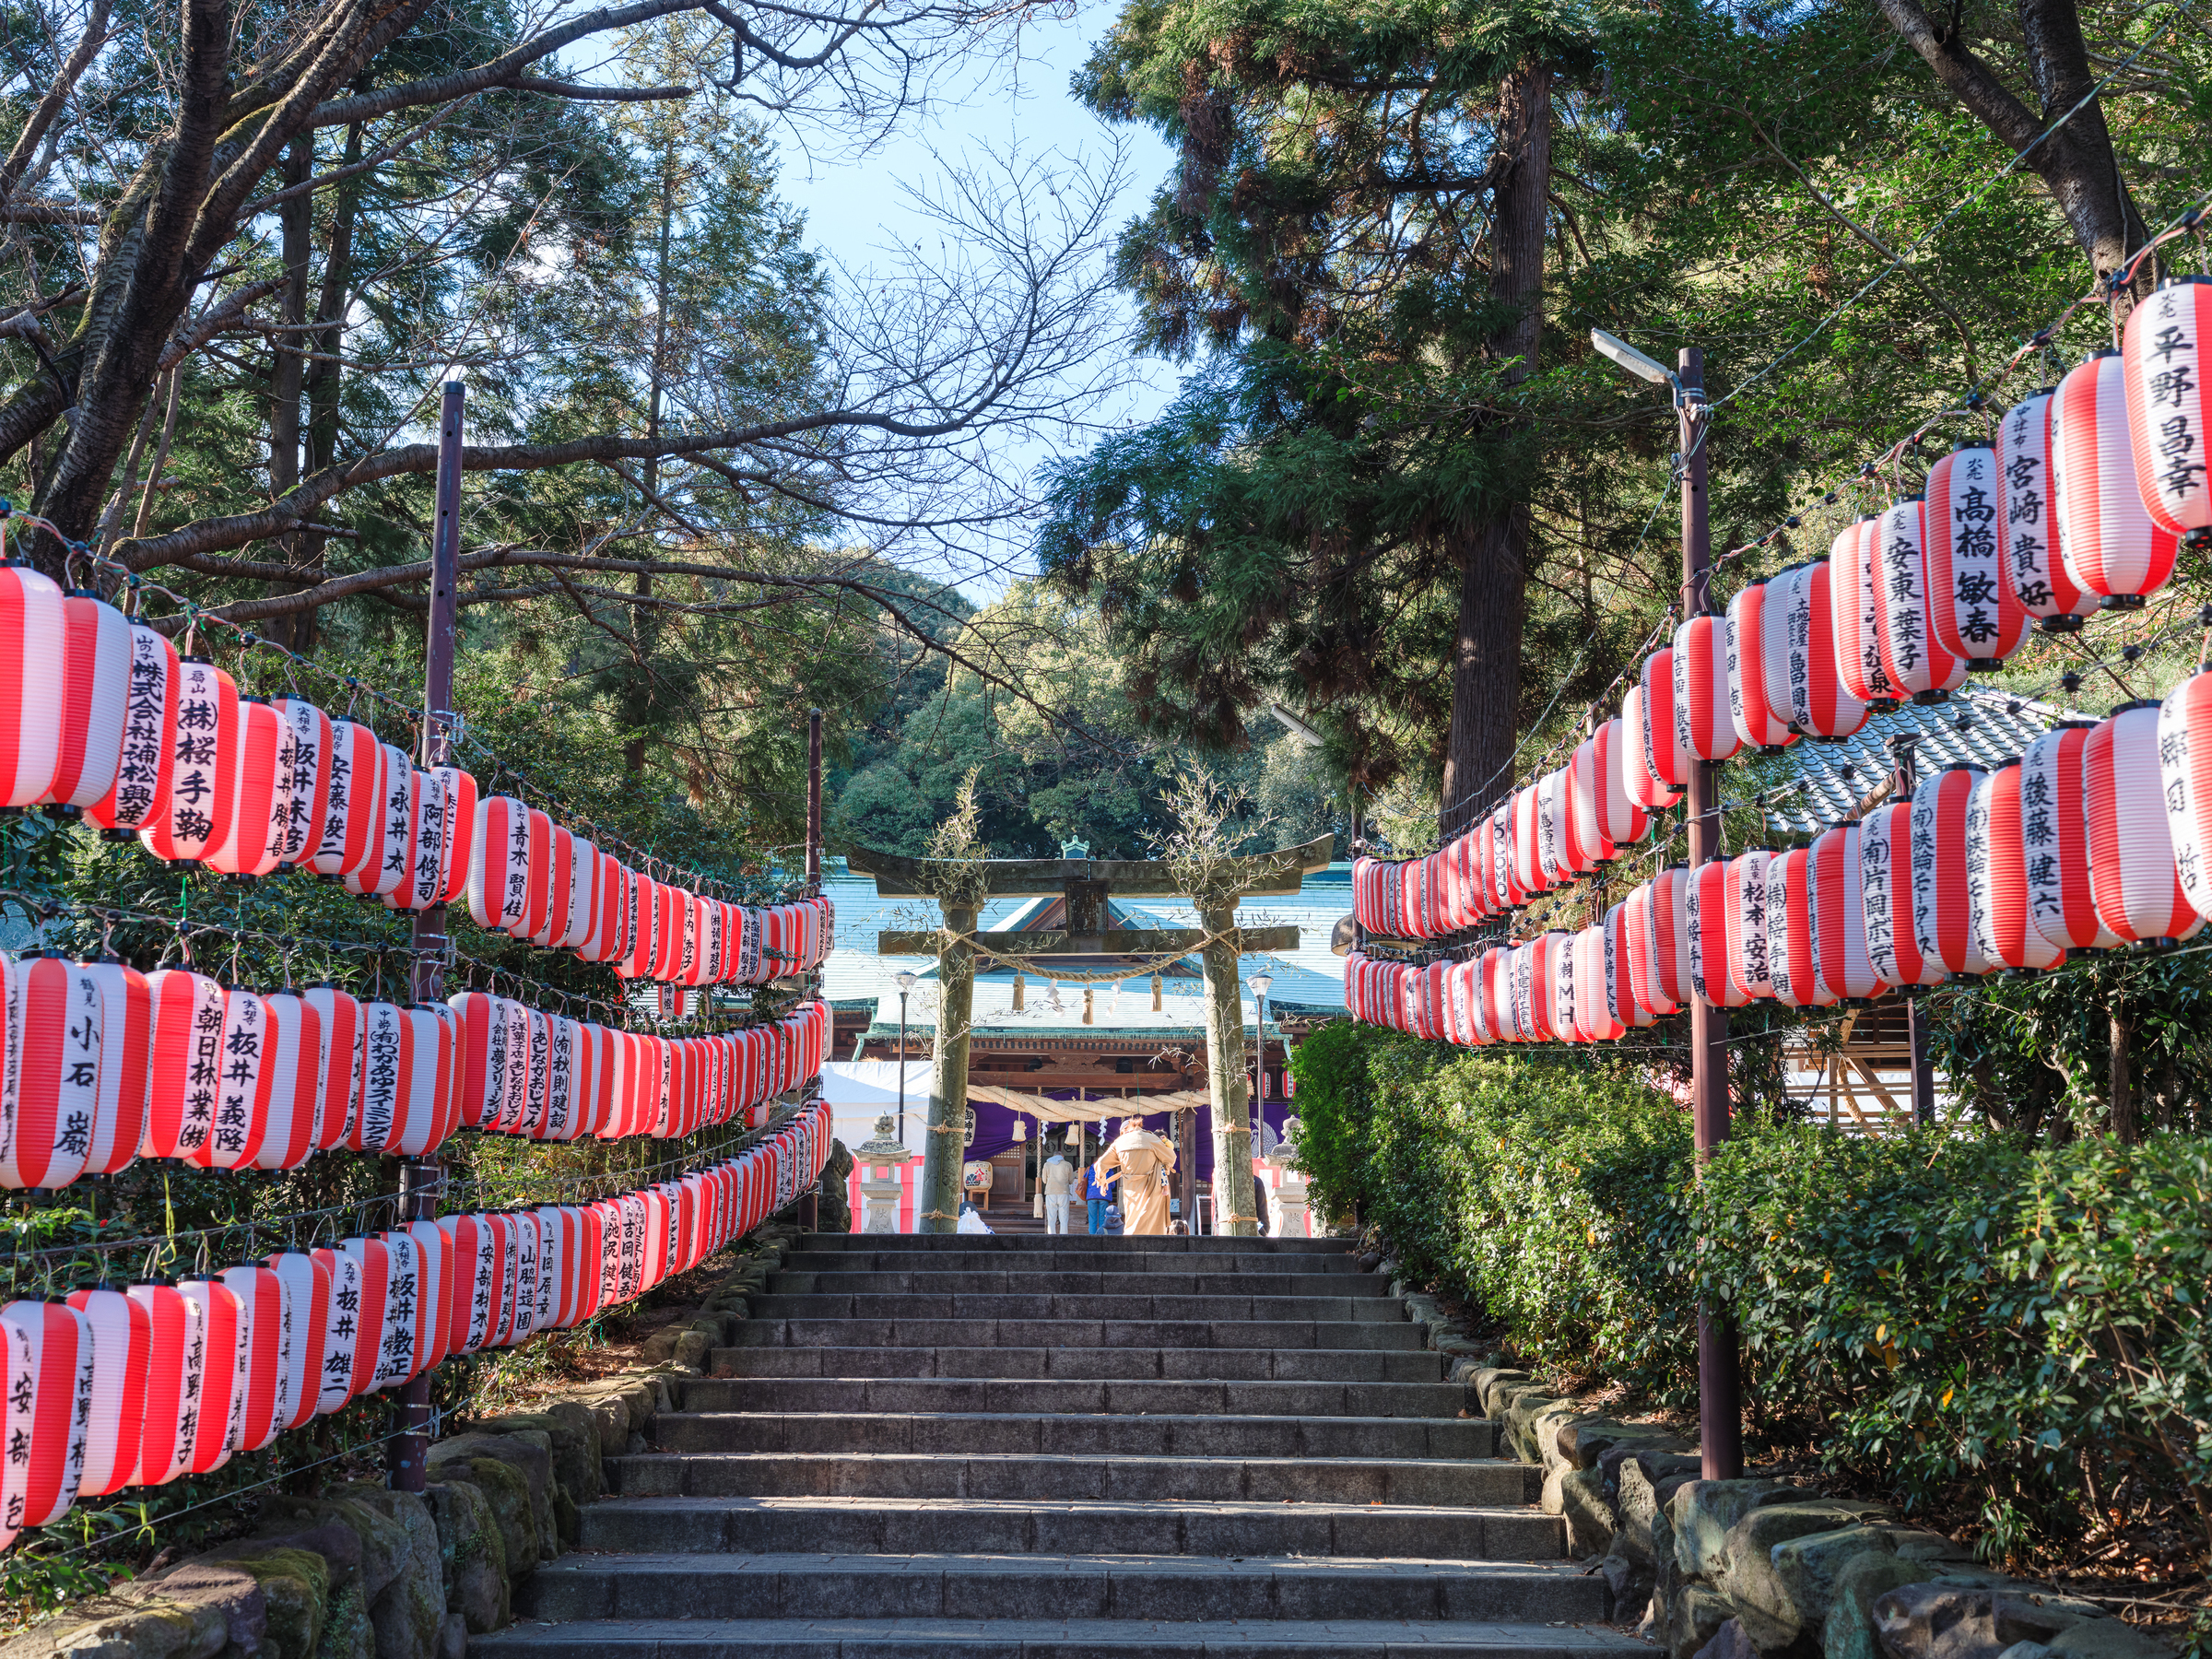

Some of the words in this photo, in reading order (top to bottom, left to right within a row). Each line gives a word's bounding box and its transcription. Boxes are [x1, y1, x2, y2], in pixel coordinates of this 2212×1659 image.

[2013, 406, 2031, 449] 中津市
[2146, 326, 2207, 498] 平野昌幸
[1885, 535, 1925, 671] 安東葉子
[297, 705, 311, 735] 実相寺
[415, 803, 444, 901] 阿部修司
[1742, 880, 1769, 982] 松本安治
[500, 1059, 526, 1127] あしながおじさん
[522, 1030, 548, 1129] あしながおじさん
[548, 1033, 571, 1130] (有)秋則建設
[515, 1244, 536, 1331] 山脇造園
[617, 1218, 636, 1299] 吉岡健吾
